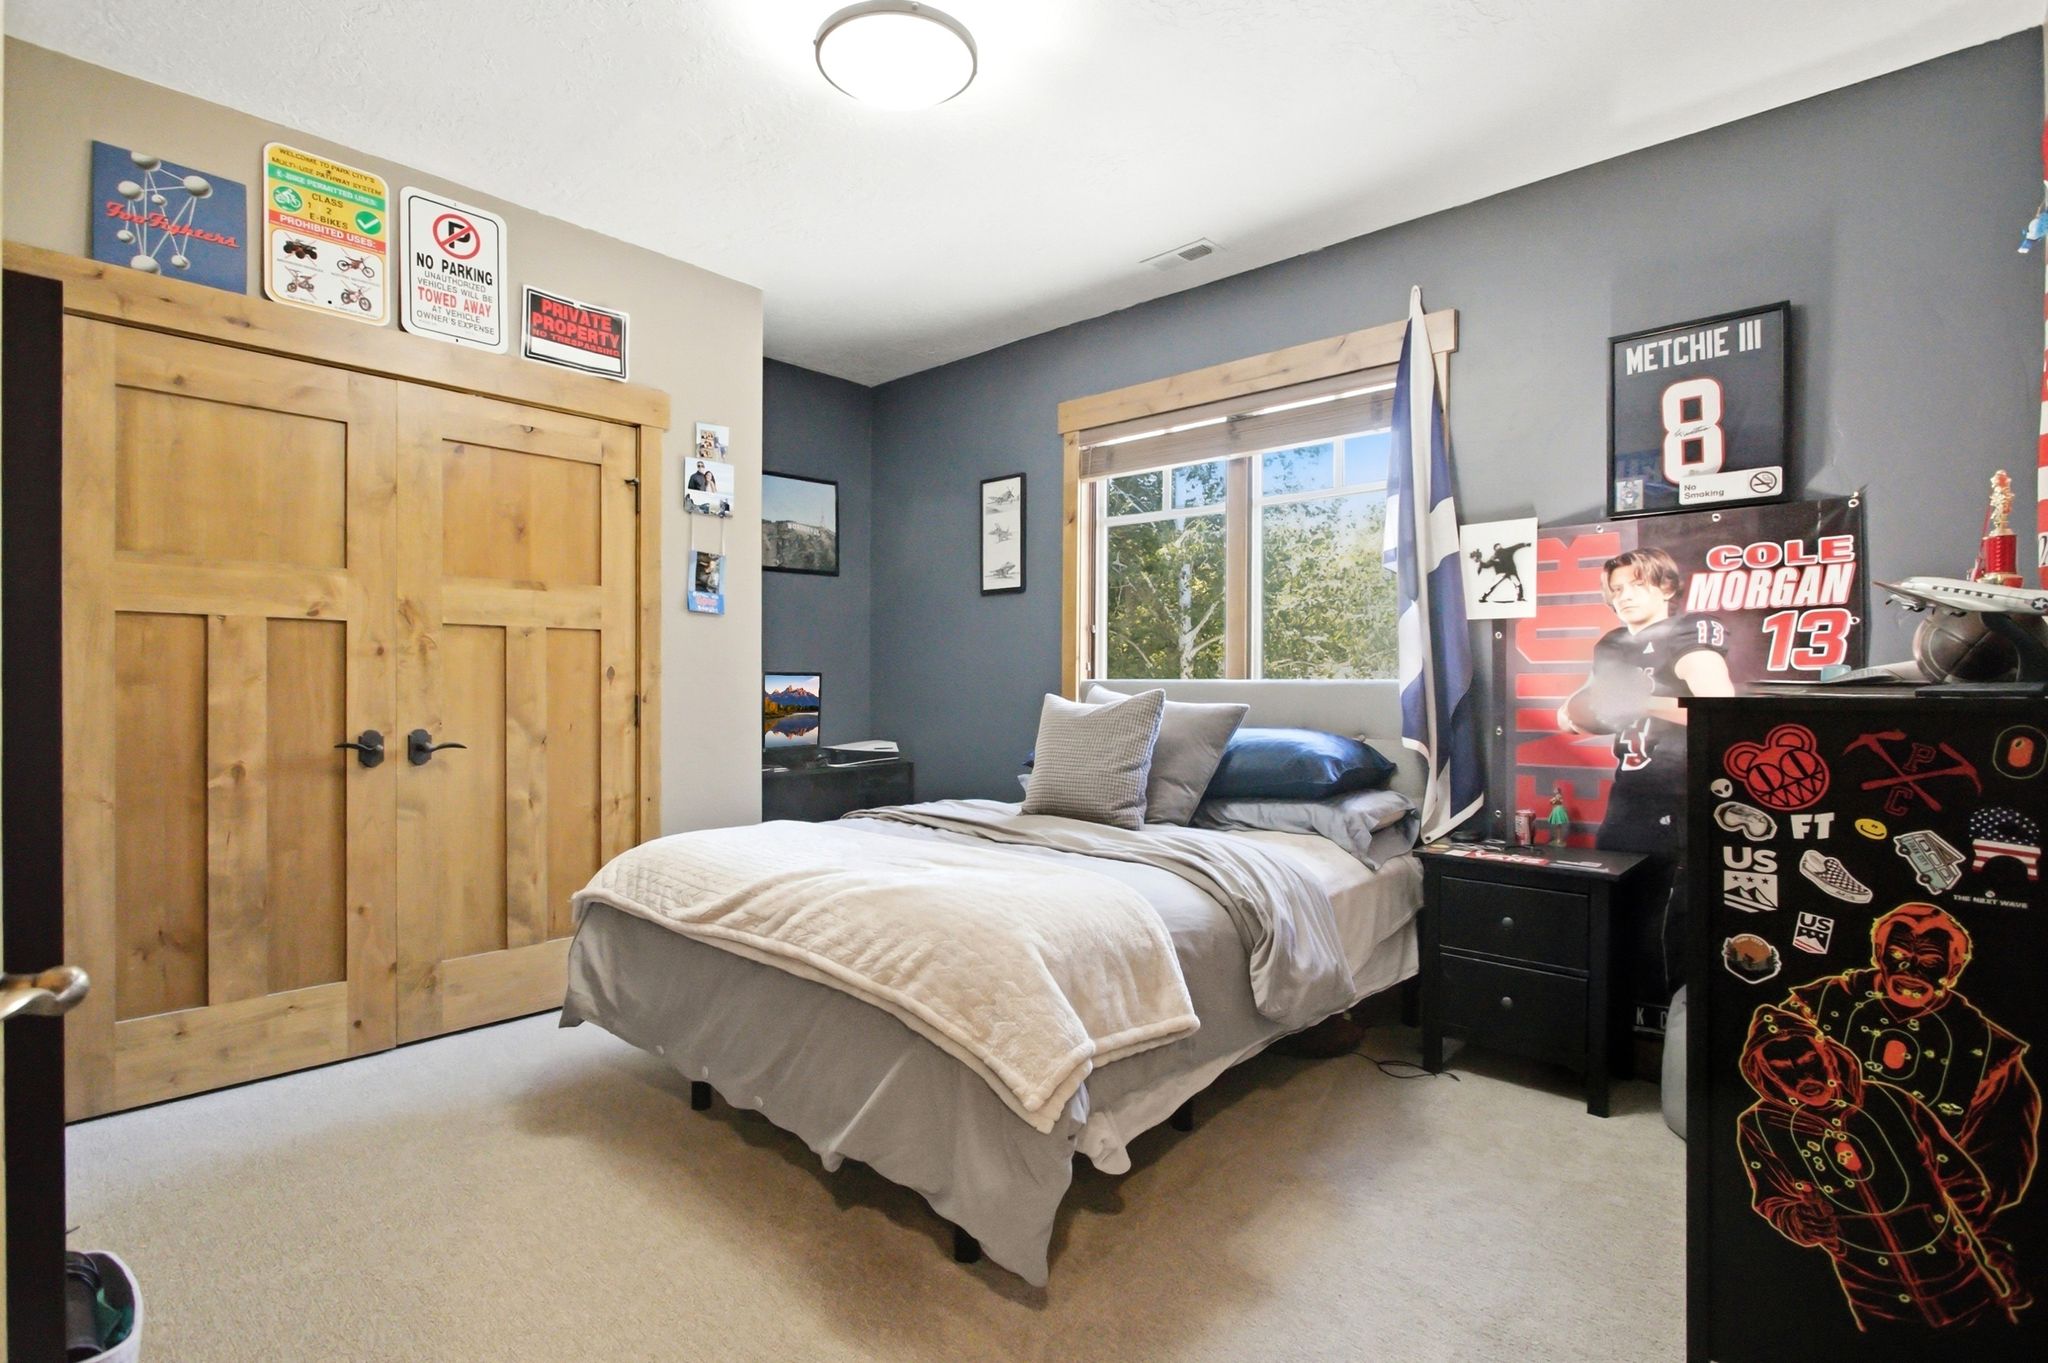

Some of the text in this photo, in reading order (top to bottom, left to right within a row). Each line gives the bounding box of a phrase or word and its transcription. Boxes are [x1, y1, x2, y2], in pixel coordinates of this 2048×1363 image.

[271, 157, 382, 196] MULTI-USE PATHWAY SYSTEM
[279, 148, 317, 164] WELCOME
[331, 165, 350, 175] PARK
[352, 172, 375, 184] CITY'S
[307, 178, 353, 200] PERMITTED
[311, 193, 344, 208] CLASS
[105, 201, 240, 248] Foo Fighters
[309, 212, 349, 230] E-BIKES
[326, 207, 332, 215] 2
[280, 214, 376, 248] PROHIBITED USES:
[416, 252, 493, 286] NO PARKING
[424, 270, 486, 293] UNAUTHORIZED
[417, 277, 493, 304] VEHICLES WILL BE
[417, 286, 492, 318] TOWED AWAY
[416, 310, 495, 336] OWNER'S EXPENSE
[432, 305, 442, 314] AT
[446, 309, 481, 324] VEHICLE
[541, 298, 612, 332] PRIVATE
[531, 311, 620, 349] PROPERTY
[531, 328, 620, 357] NO TRESPASSING
[1625, 319, 1763, 376] METCHIE III
[1662, 376, 1725, 485] 8
[1684, 484, 1697, 492] No
[1684, 489, 1725, 499] Smoking
[1706, 535, 1856, 572] COLE
[1683, 562, 1857, 614] MORGAN
[1696, 620, 1725, 646] 13
[1762, 608, 1852, 672] 13
[1790, 812, 1835, 840] FT
[1723, 846, 1778, 874] US
[1952, 893, 1972, 902] THE
[1999, 899, 2028, 909] WAVE
[1799, 913, 1831, 931] US
